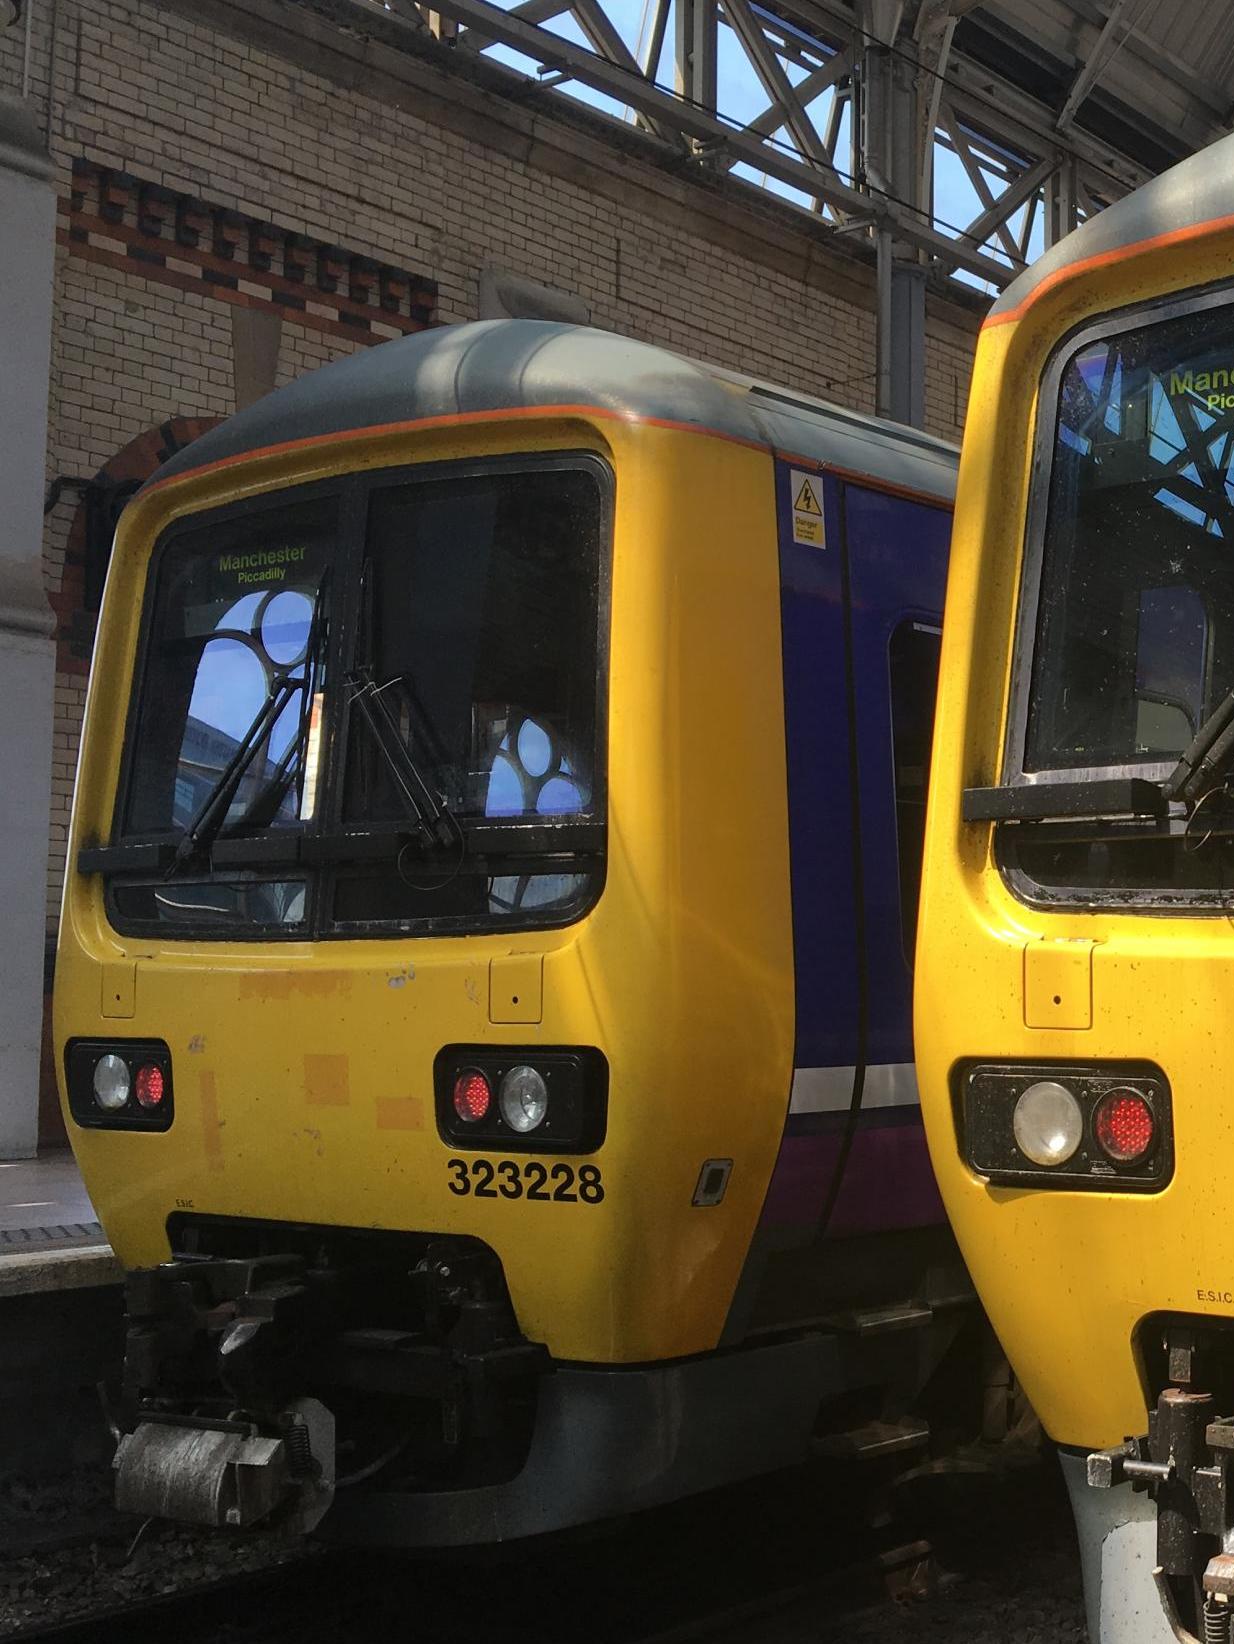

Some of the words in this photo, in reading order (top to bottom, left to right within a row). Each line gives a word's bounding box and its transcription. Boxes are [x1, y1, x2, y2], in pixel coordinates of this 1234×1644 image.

[219, 546, 306, 571] Manchester
[238, 567, 286, 584] Piccadilly
[447, 1158, 605, 1204] 323228
